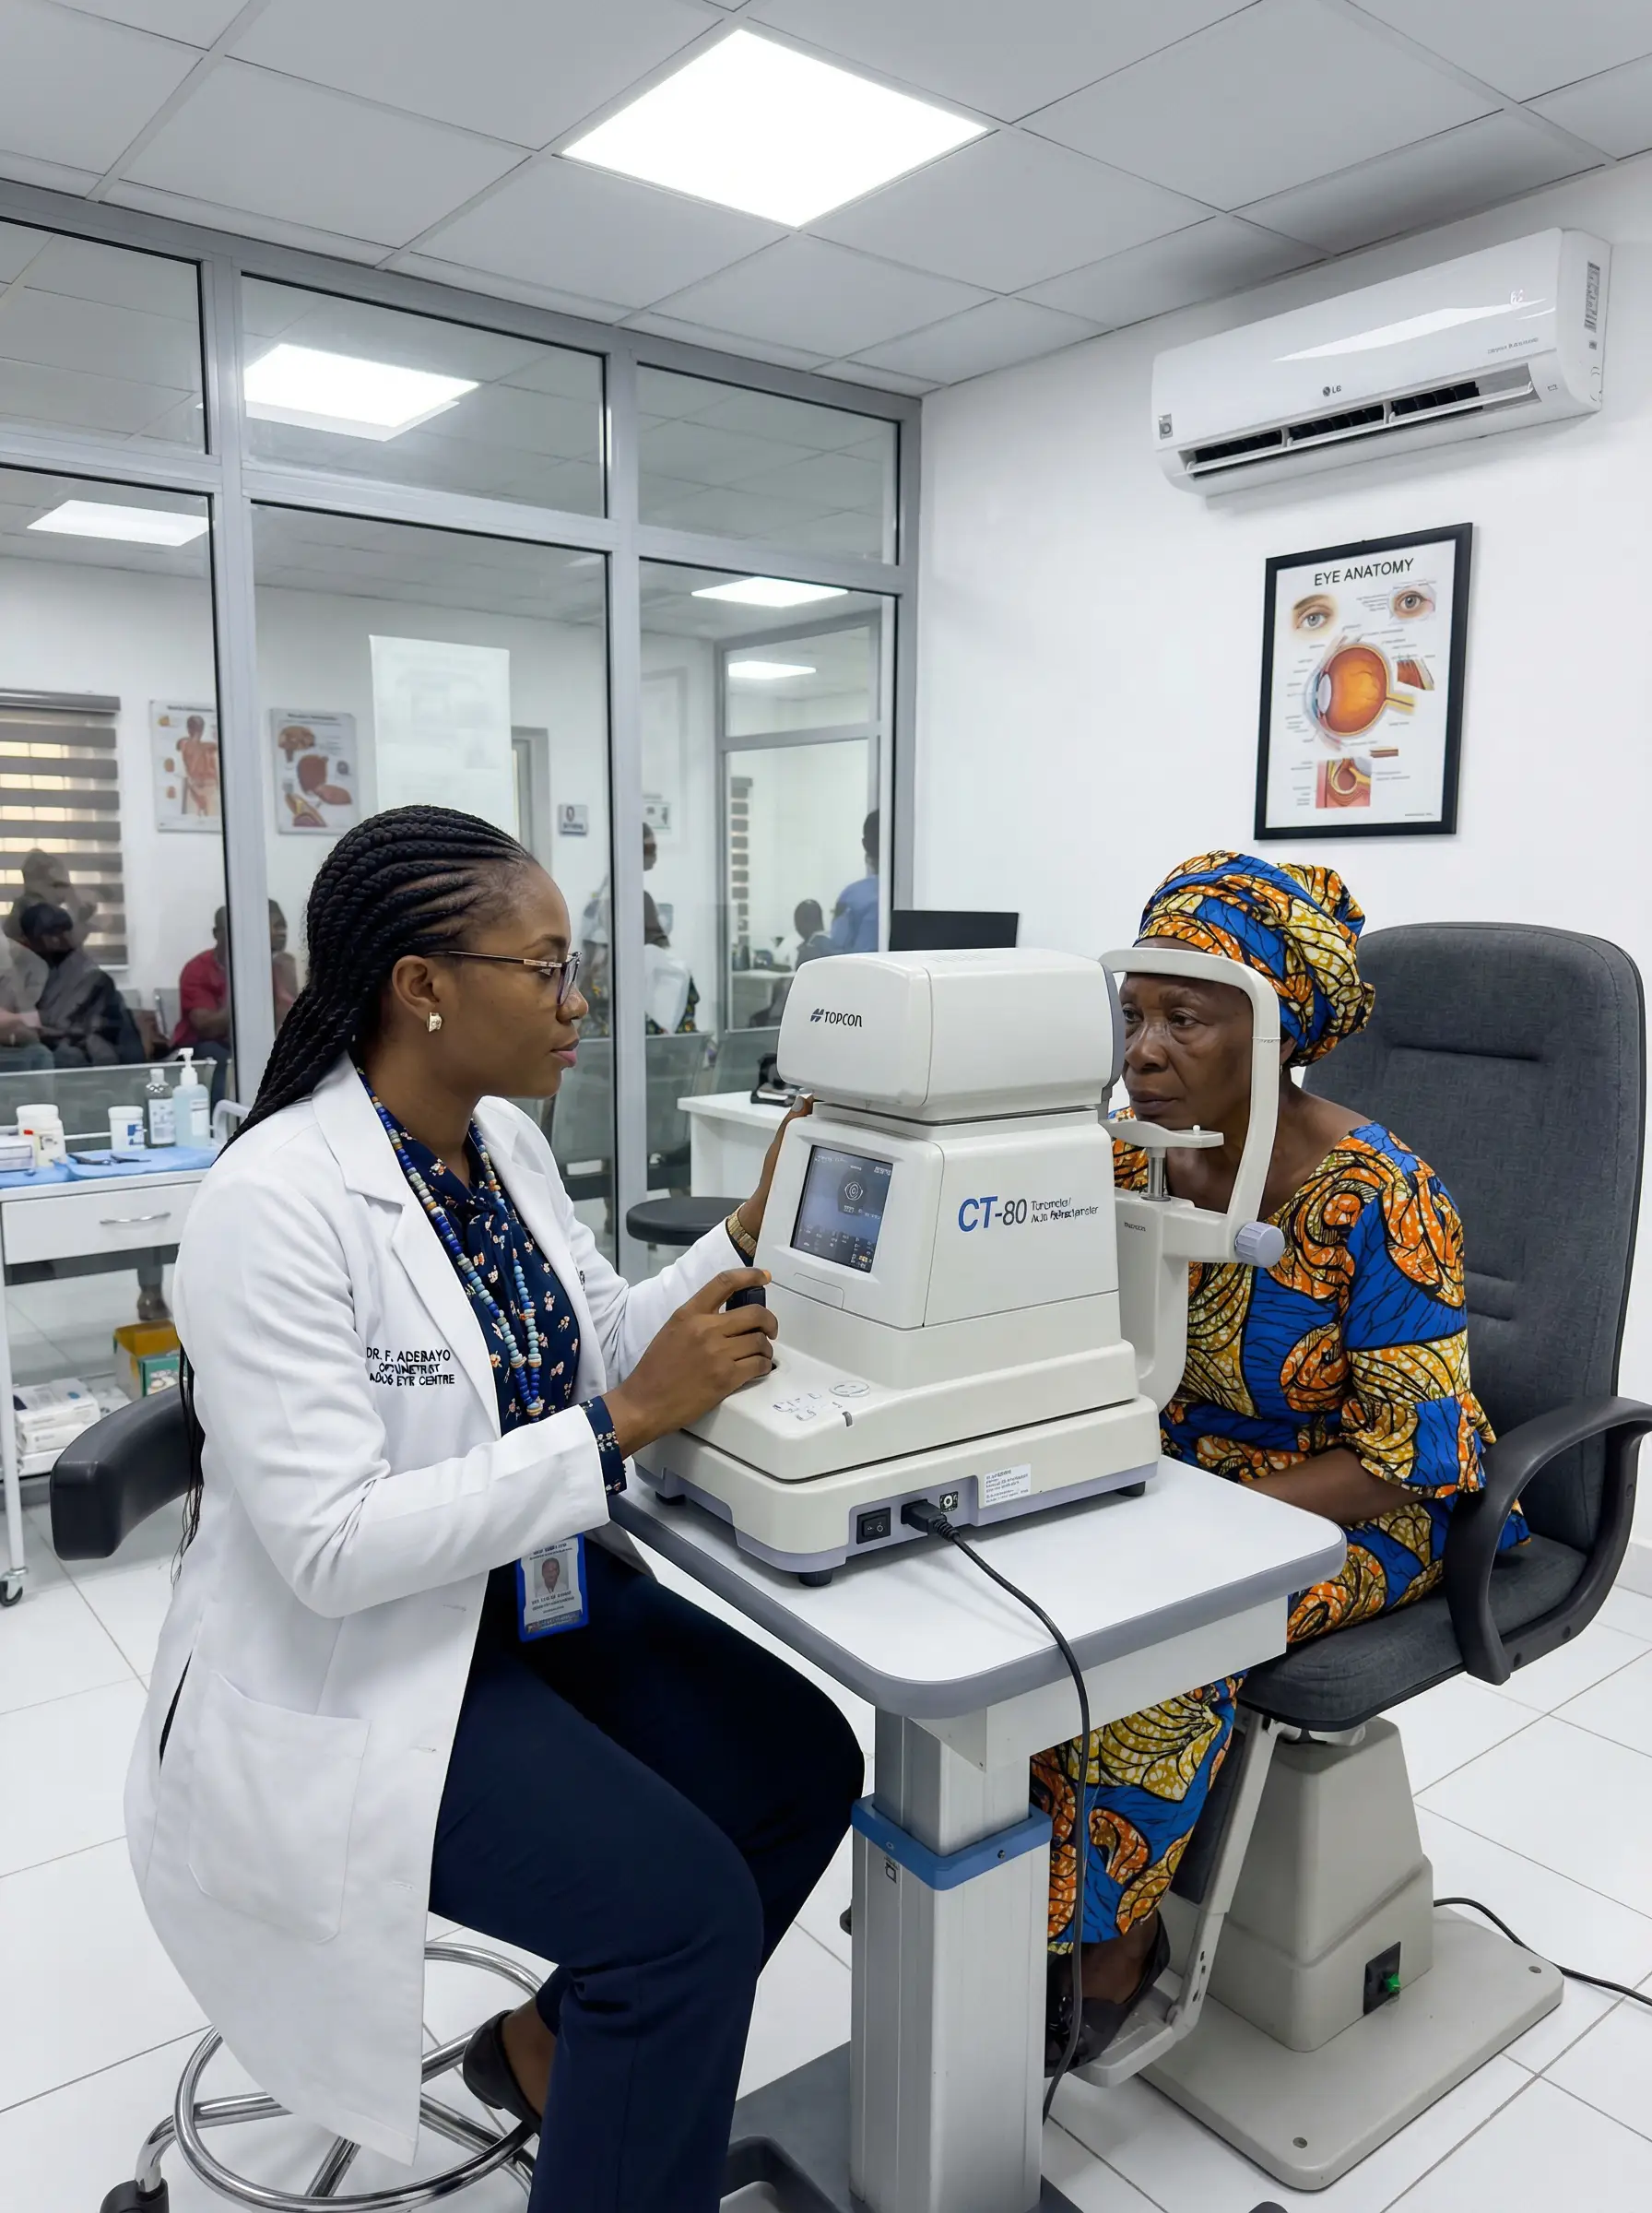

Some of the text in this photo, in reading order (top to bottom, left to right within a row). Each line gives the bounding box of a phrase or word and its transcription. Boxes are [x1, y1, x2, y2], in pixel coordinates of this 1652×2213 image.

[1315, 558, 1414, 586] EYE ANATOMY
[825, 1011, 863, 1027] TOPCON
[958, 1196, 1028, 1233] CT-80
[366, 1347, 382, 1360] DR.
[385, 1350, 394, 1362] F.
